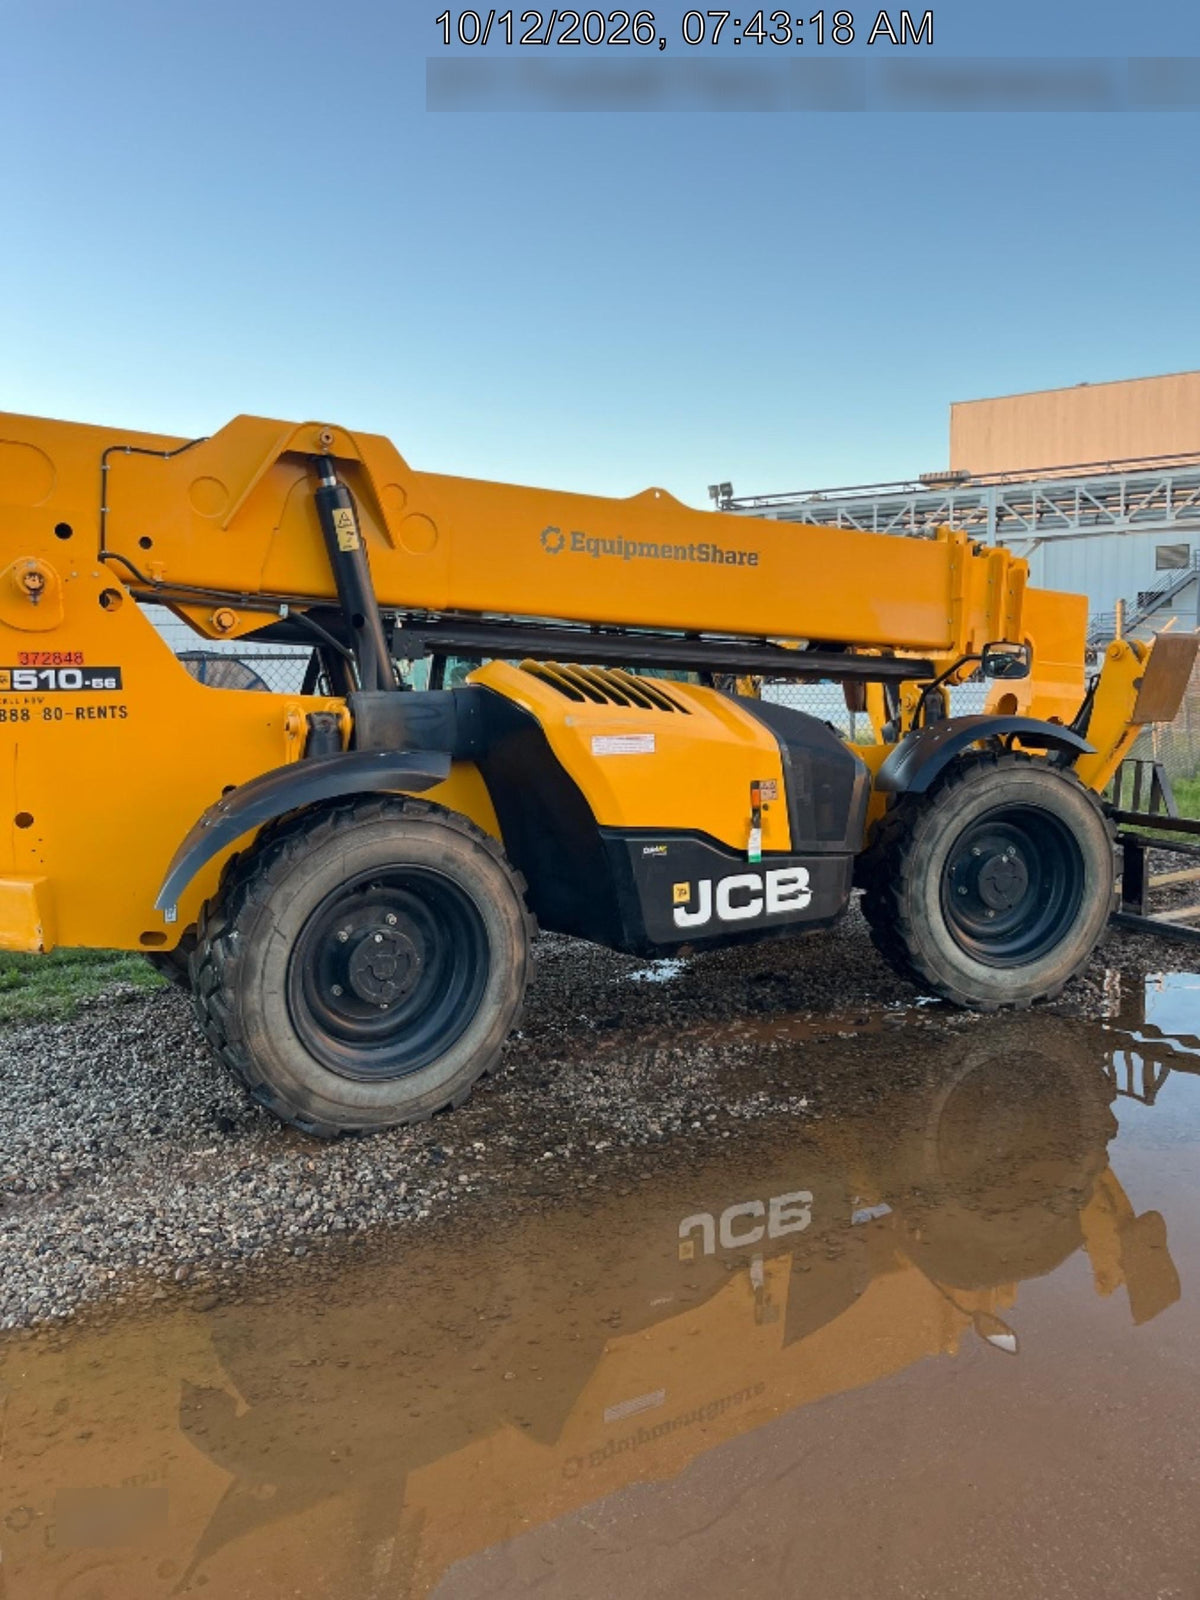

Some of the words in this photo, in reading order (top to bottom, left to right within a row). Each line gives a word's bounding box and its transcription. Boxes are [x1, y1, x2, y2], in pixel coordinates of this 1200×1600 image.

[570, 531, 759, 567] EquipmentShare
[19, 651, 84, 666] 372848
[673, 867, 813, 928] JCB
